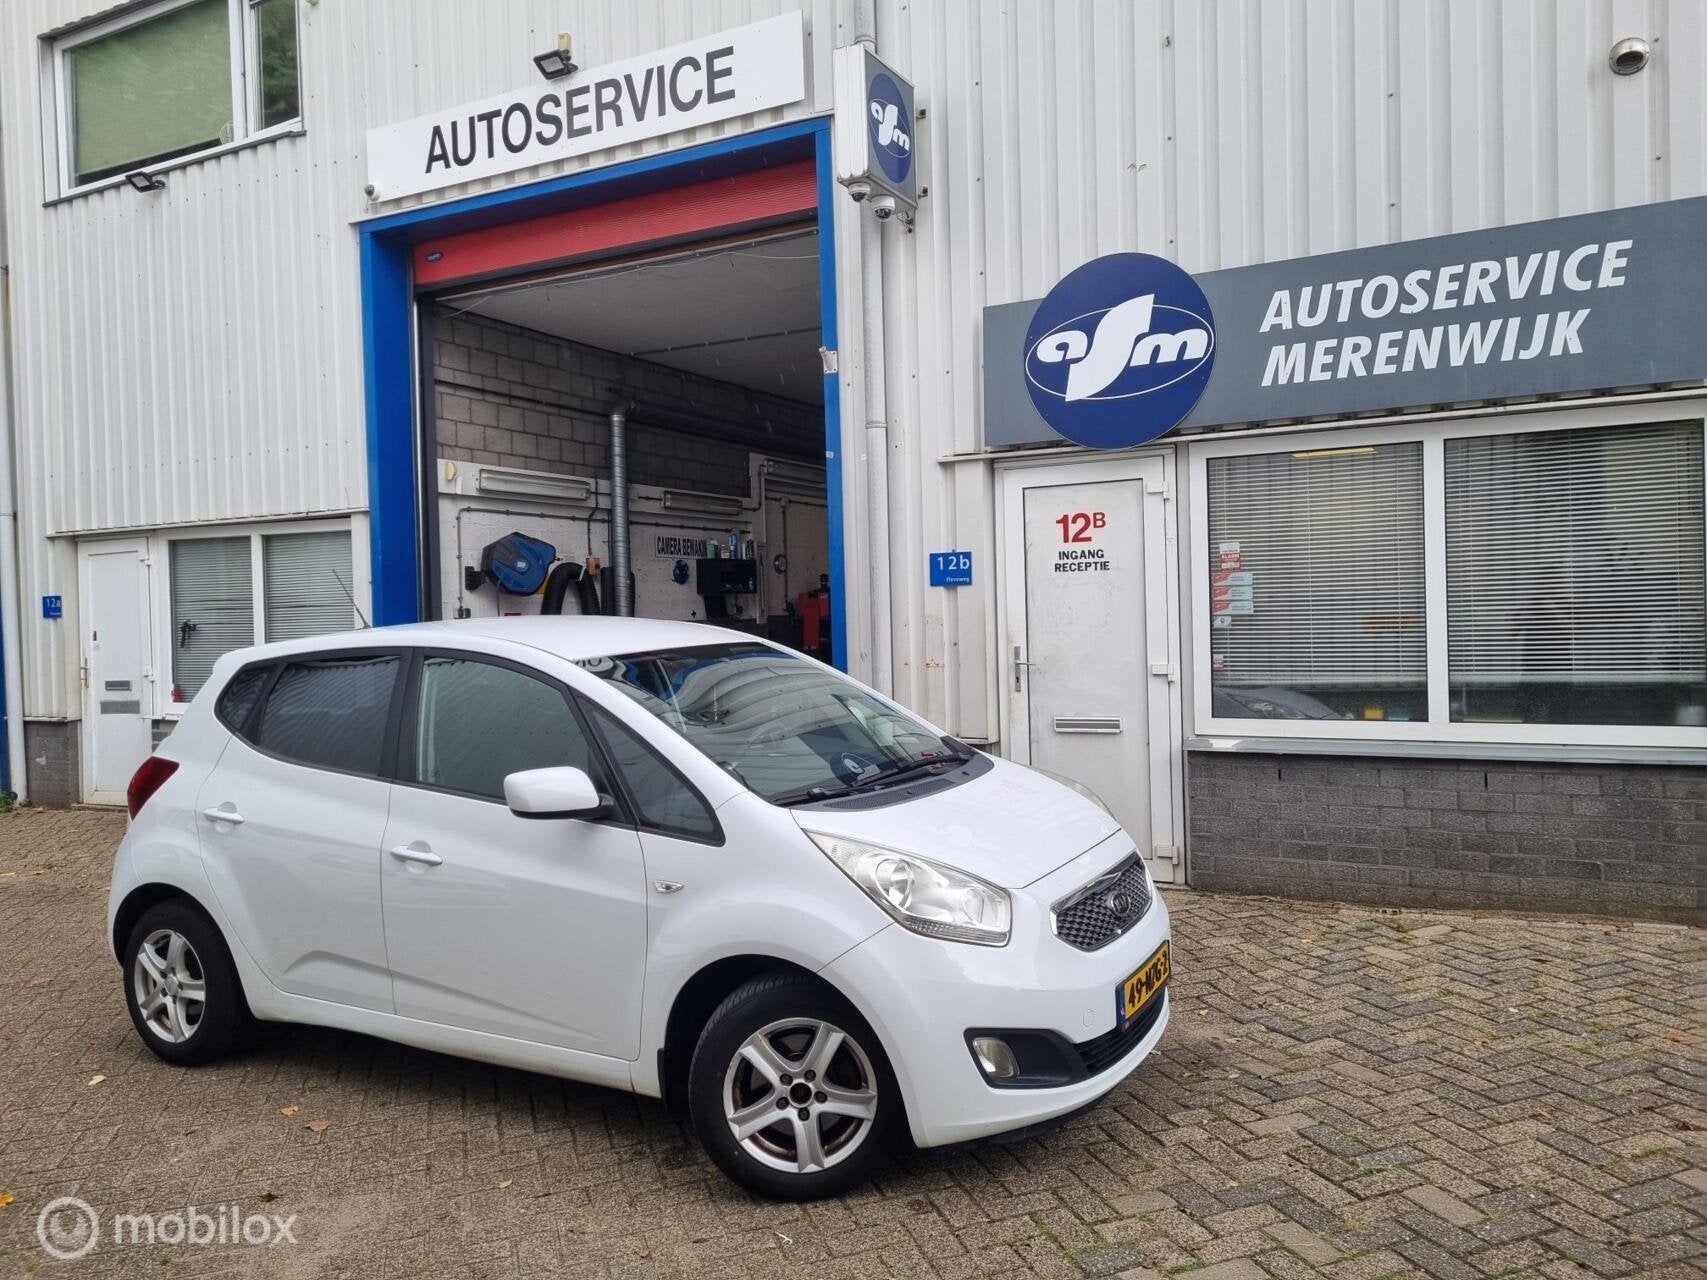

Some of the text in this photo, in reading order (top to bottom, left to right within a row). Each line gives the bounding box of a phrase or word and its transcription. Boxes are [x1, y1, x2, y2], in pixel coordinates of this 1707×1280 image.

[425, 46, 736, 174] AUTOSERVICE
[1259, 240, 1633, 333] AUTOSERVICE
[1261, 309, 1591, 387] MERENWIJK
[657, 536, 682, 555] CAMERA
[1054, 561, 1110, 572] RECEPTIE
[1058, 549, 1104, 560] INGANG
